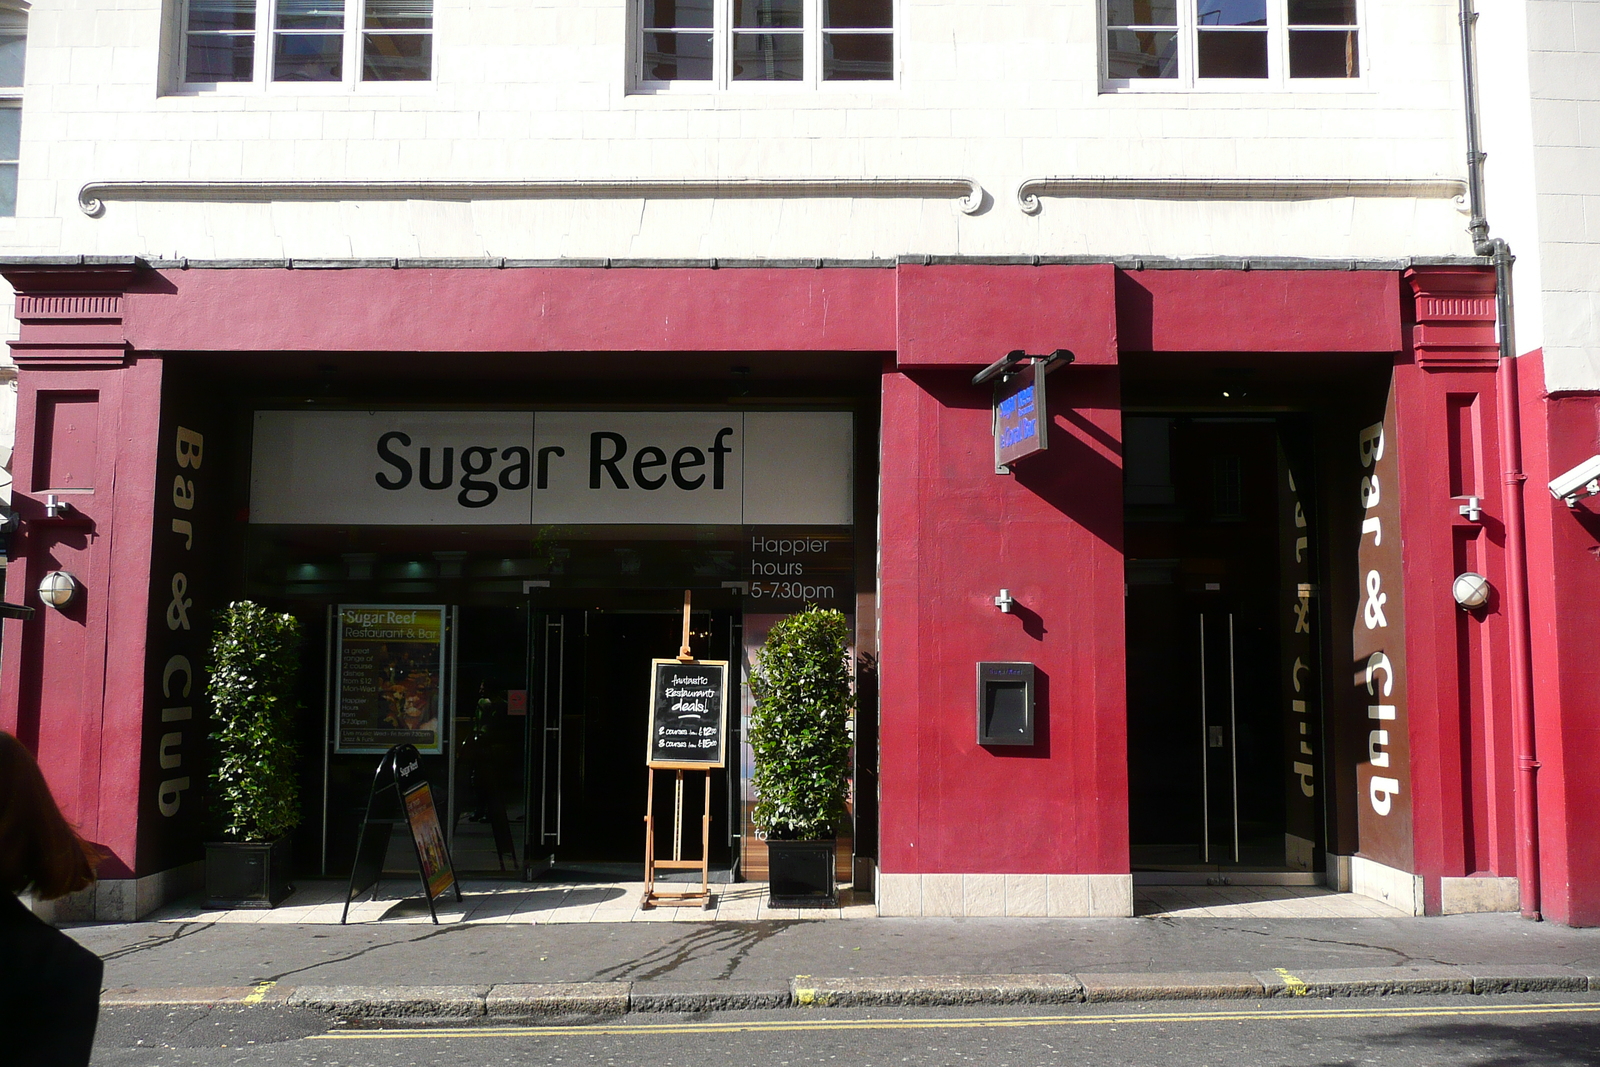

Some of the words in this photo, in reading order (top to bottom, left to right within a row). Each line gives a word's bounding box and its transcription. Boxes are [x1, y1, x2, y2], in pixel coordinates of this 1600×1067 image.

[171, 426, 204, 551] Bar
[375, 431, 565, 508] Sugar
[589, 426, 733, 491] Reef
[1358, 420, 1384, 547] Bar
[752, 536, 830, 556] Happier
[752, 559, 803, 575] hours
[166, 571, 191, 632] &
[346, 610, 386, 627] Sugar
[387, 610, 417, 624] Reef
[751, 582, 834, 602] 5-7.30pm
[1363, 569, 1388, 630] &
[345, 627, 403, 638] Restaurant
[406, 628, 416, 639] &
[418, 628, 436, 639] Bar
[351, 648, 370, 656] great
[158, 655, 193, 819] Club
[1365, 652, 1399, 817] Club
